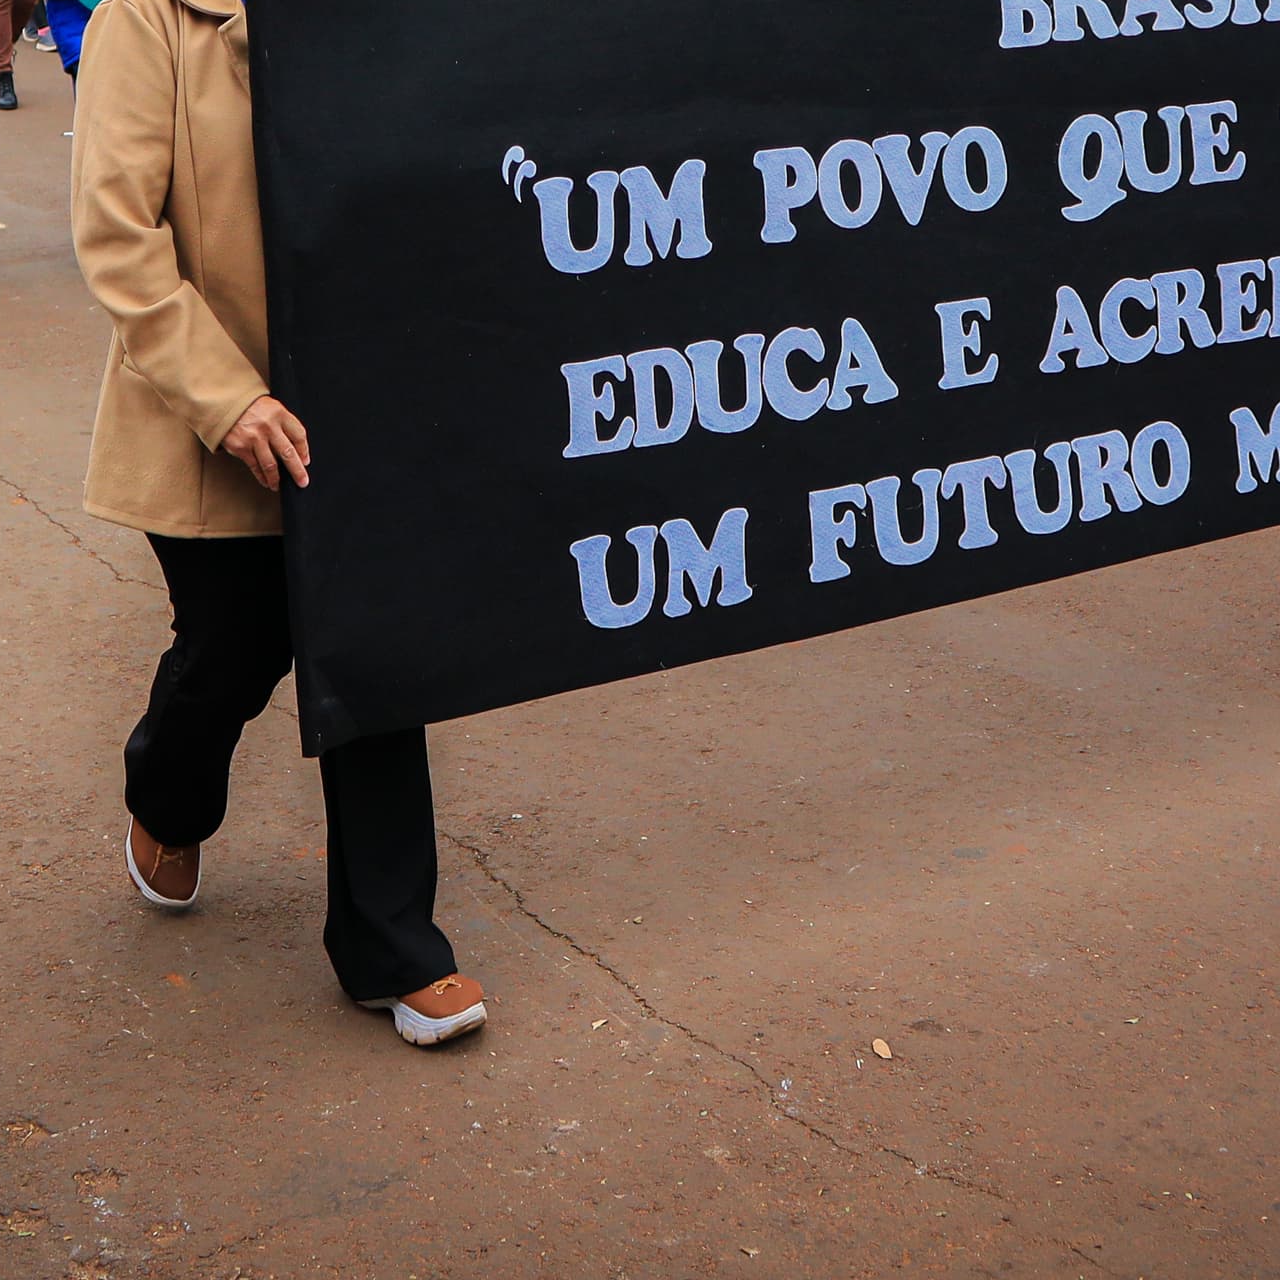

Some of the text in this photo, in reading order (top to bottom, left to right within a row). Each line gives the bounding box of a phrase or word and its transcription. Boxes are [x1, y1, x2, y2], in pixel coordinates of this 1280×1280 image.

[753, 126, 1008, 244] POVO
[1057, 99, 1247, 223] QUE
[560, 317, 900, 459] EDUCA
[934, 296, 1000, 391] E
[569, 507, 753, 629] UM
[809, 420, 1191, 584] FUTURO
